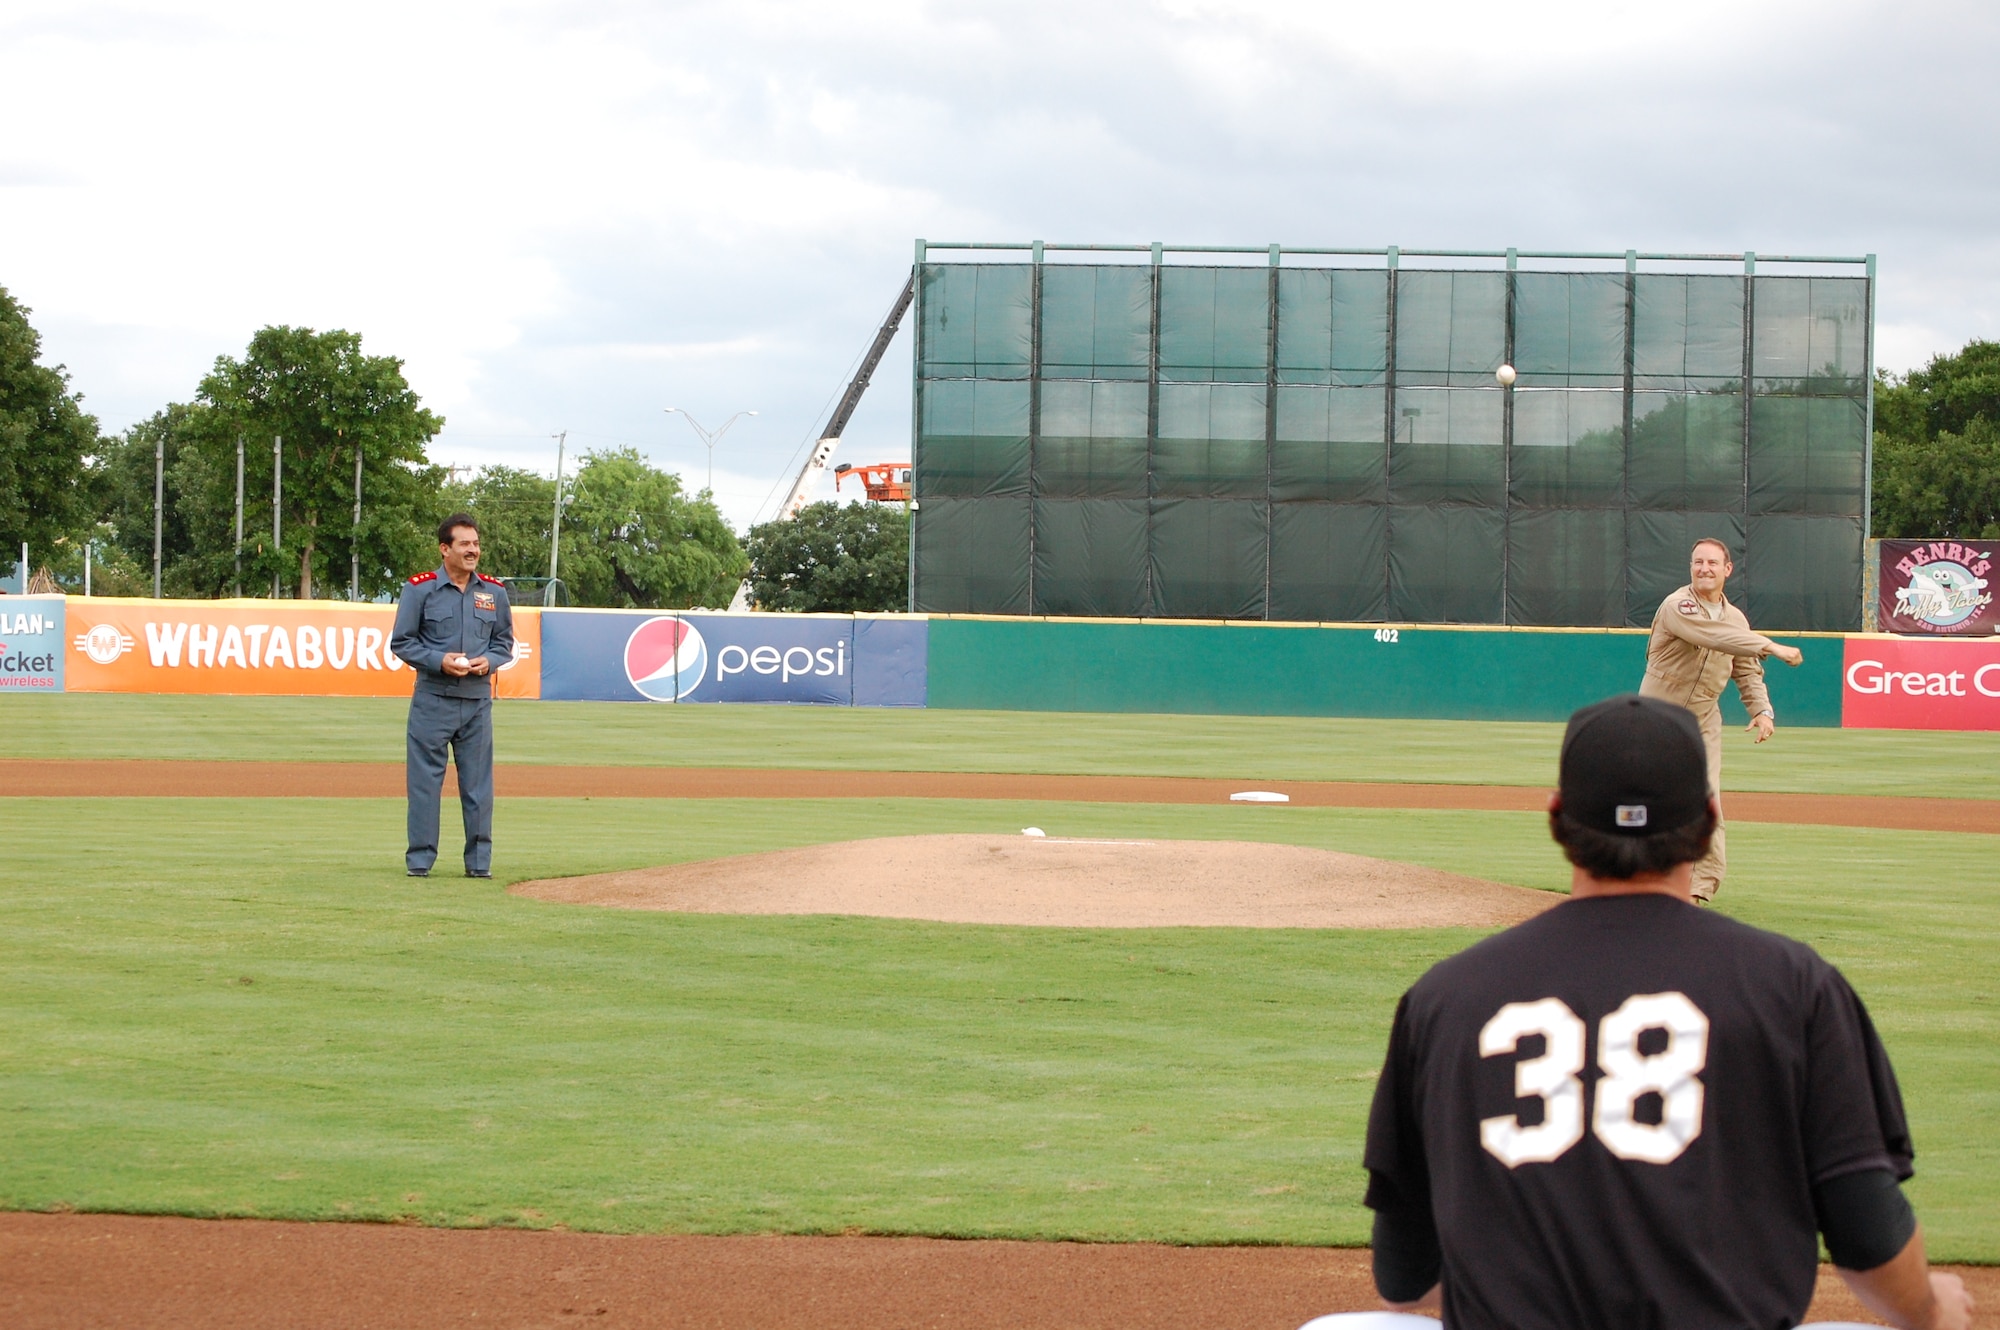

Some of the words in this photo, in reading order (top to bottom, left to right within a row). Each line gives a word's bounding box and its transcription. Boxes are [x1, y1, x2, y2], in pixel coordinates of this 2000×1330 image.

[1895, 542, 1992, 578] HENRY'S
[1893, 594, 1941, 620] Puffy
[1947, 591, 1993, 610] Tacos
[1373, 628, 1399, 643] 402
[1916, 619, 1934, 632] SAN
[0, 651, 54, 673] cket
[716, 640, 845, 683] pepsi
[0, 675, 55, 687] wireless
[1846, 660, 1967, 697] Great
[1478, 991, 1710, 1170] 38
